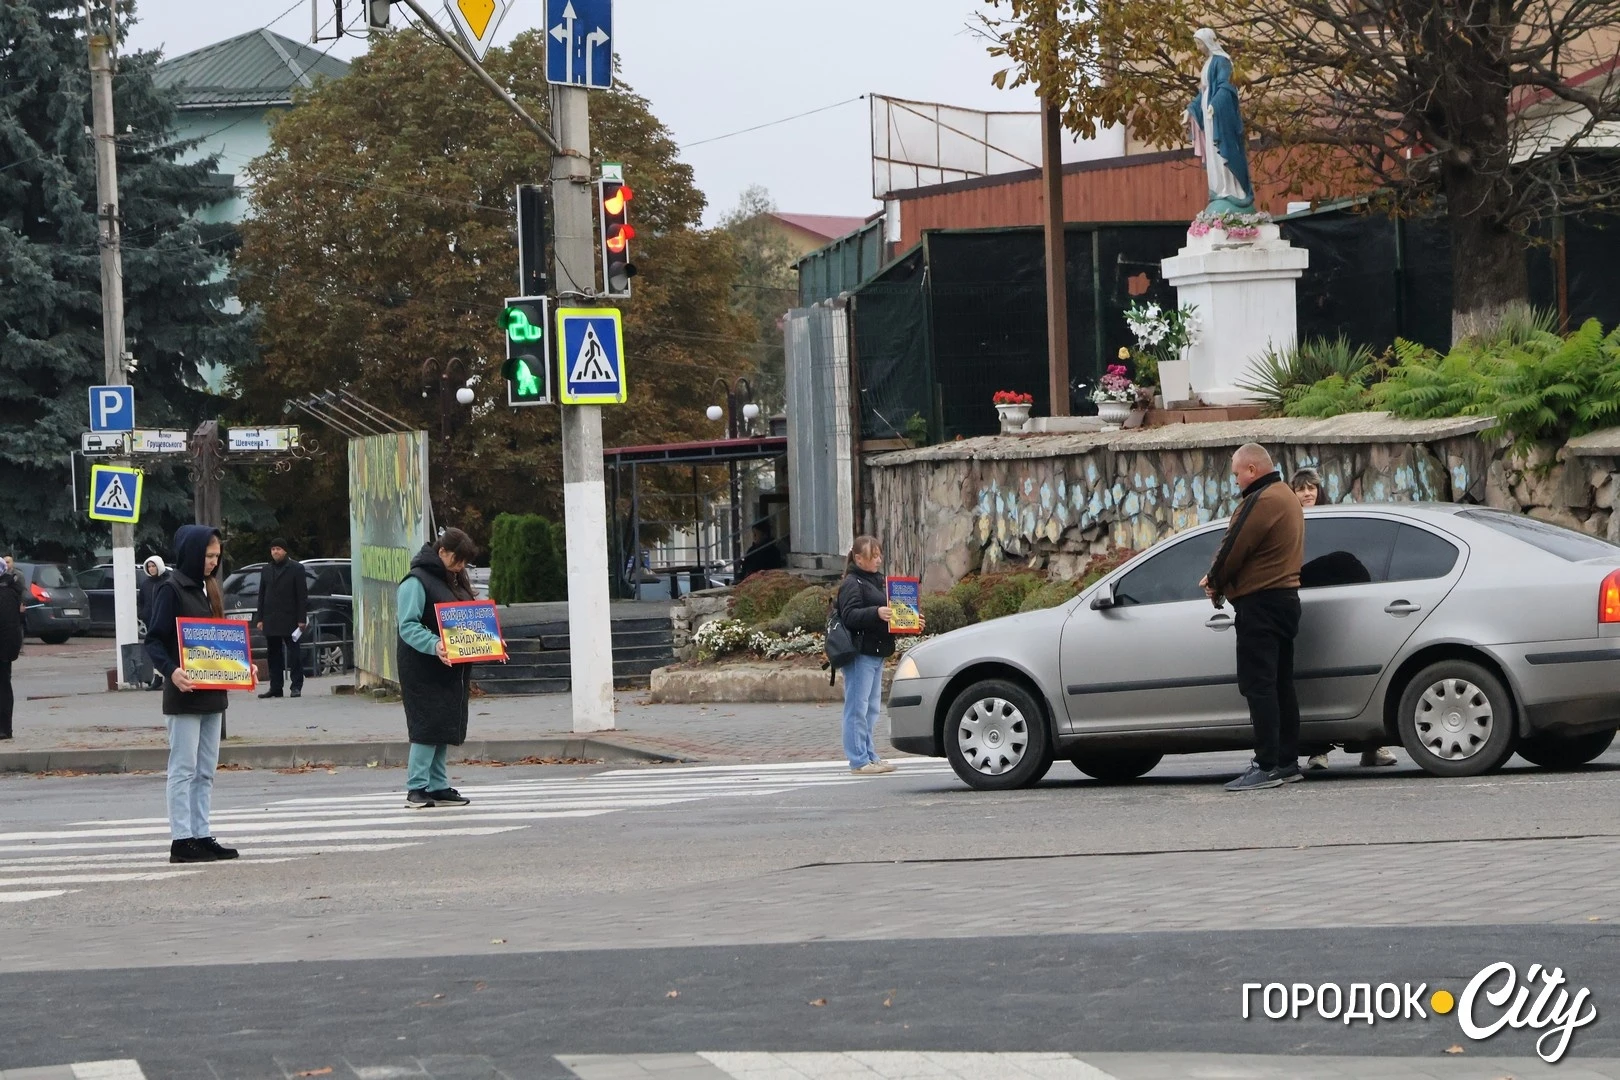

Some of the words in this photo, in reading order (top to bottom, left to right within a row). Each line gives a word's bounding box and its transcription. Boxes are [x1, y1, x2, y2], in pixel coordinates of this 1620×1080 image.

[99, 391, 123, 427] P
[440, 608, 467, 621] ВИЙДИ
[458, 643, 493, 656] ВШАНУЙ!
